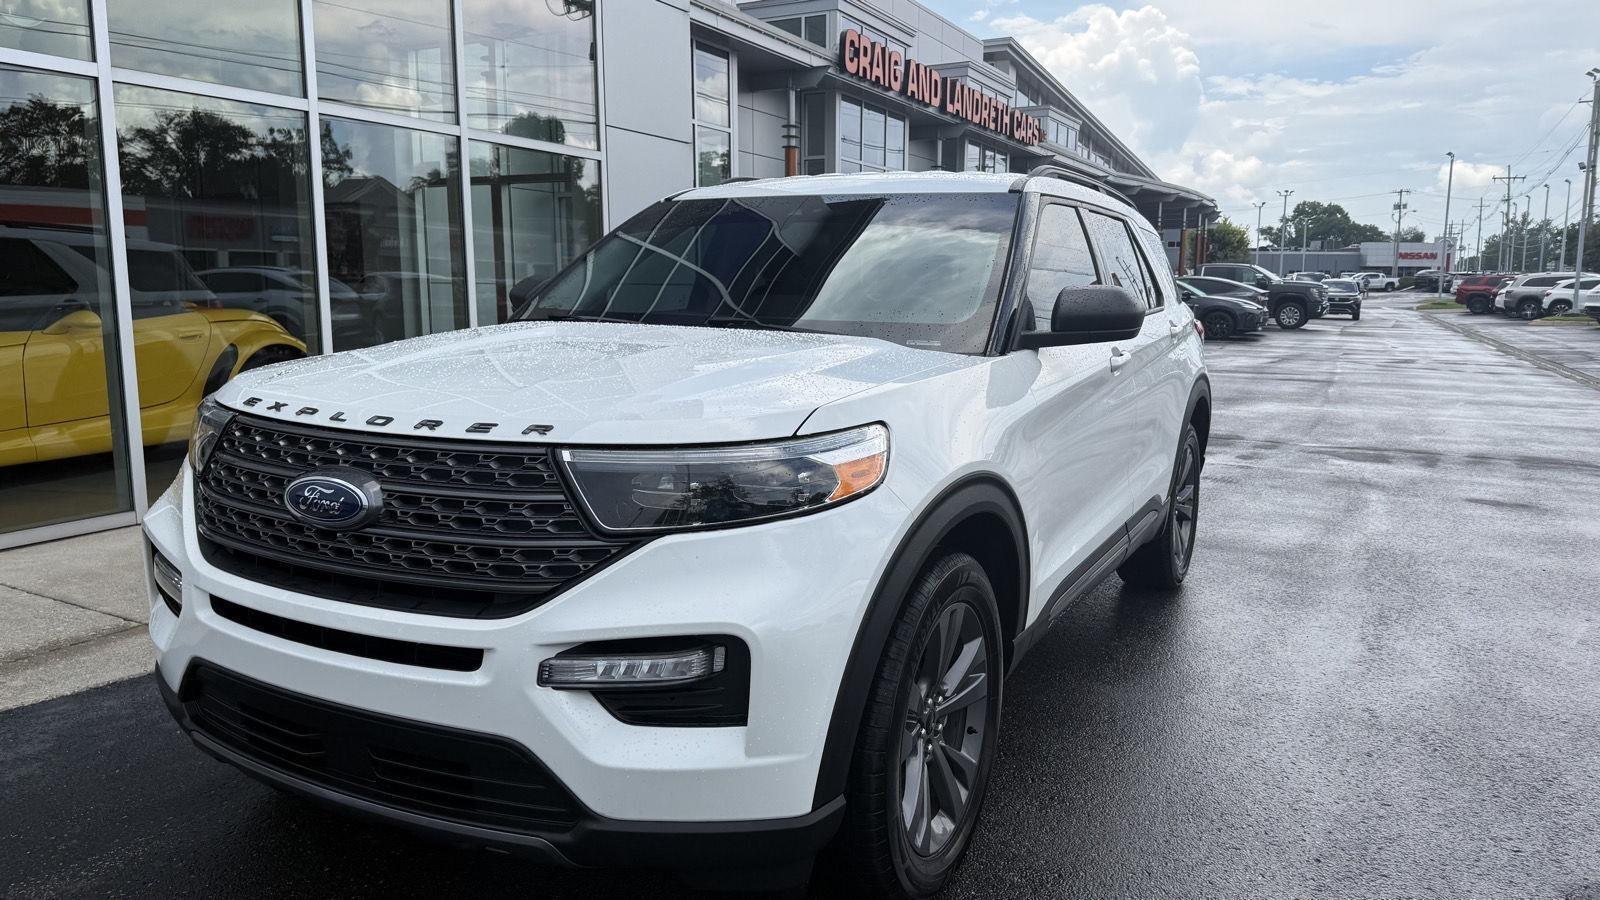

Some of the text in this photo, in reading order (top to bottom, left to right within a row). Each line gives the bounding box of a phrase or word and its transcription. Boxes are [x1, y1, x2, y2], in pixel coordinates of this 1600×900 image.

[843, 29, 1040, 146] CRAIG AND LANDRETH CARS
[1398, 252, 1438, 260] NISSAN
[242, 396, 555, 436] EXPLORER
[299, 484, 345, 515] Ford
